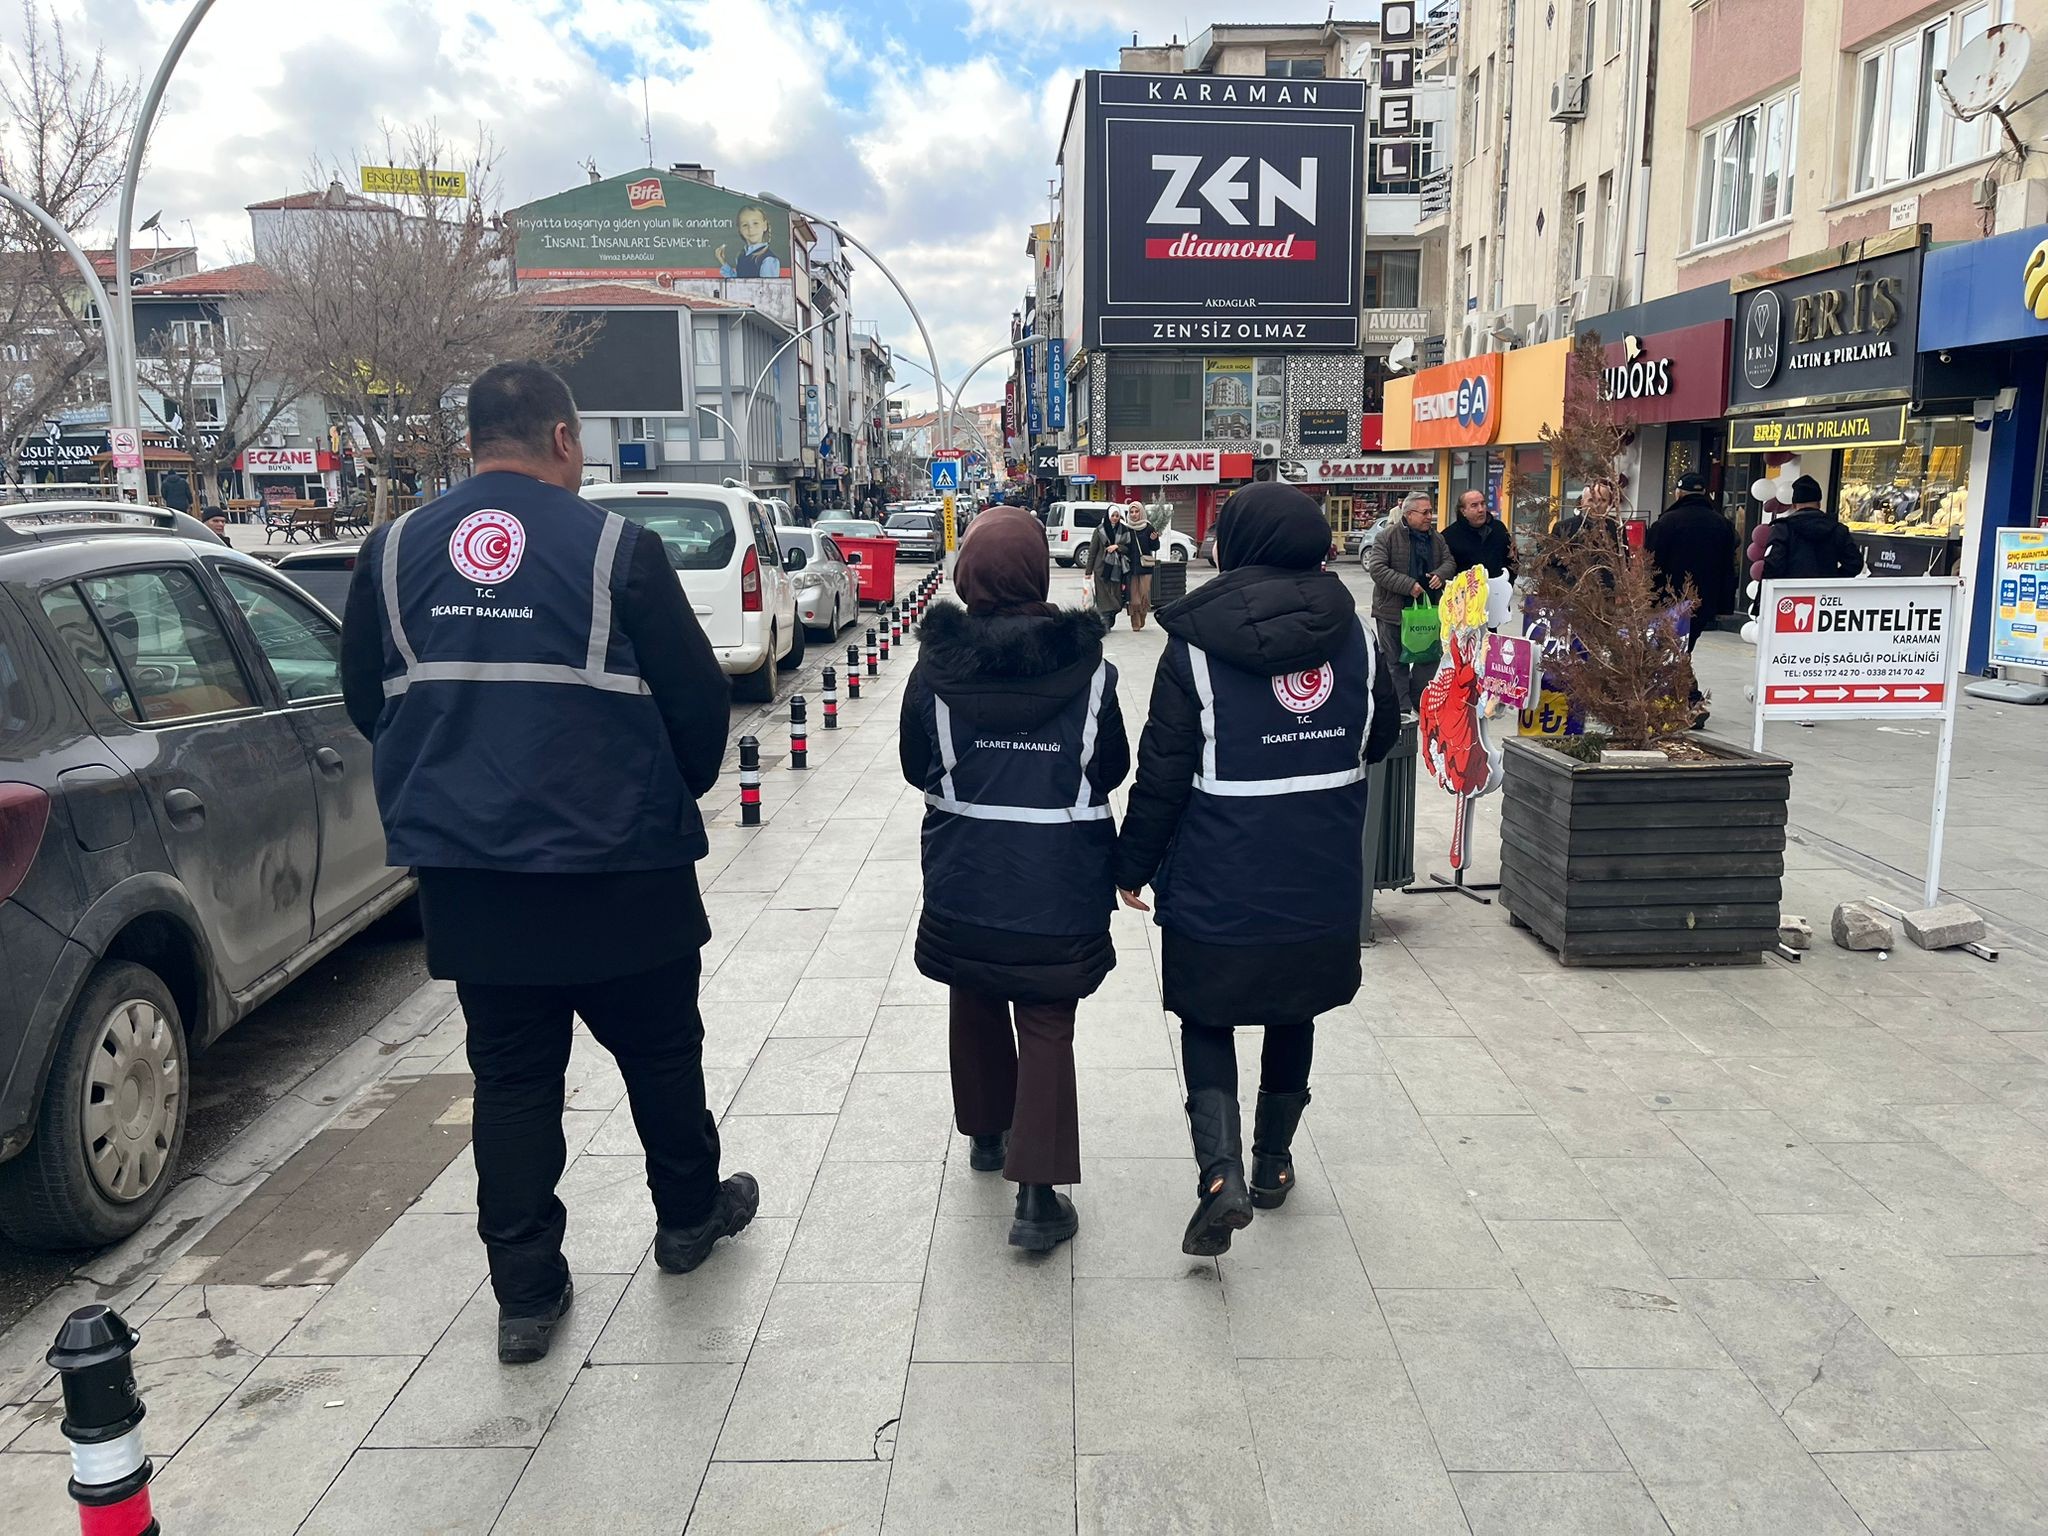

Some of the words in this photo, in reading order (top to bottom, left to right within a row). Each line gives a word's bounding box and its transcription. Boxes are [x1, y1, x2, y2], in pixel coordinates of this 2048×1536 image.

[1149, 82, 1317, 104] KARAMAN
[1383, 6, 1411, 176] OTEL
[429, 175, 460, 188] TIME
[630, 184, 662, 200] Bifa
[1146, 154, 1318, 227] ZEN
[516, 218, 562, 231] Hayatta
[564, 218, 610, 231] başarıya
[613, 218, 640, 232] giden
[643, 218, 670, 231] yolun
[686, 218, 732, 228] anahtarı
[591, 234, 650, 248] İNSANLARI
[1168, 232, 1296, 258] diamond
[622, 252, 655, 261] BABAOĞLU
[1789, 270, 1896, 344] ERİŞ
[1369, 313, 1427, 329] AVUKAT
[1153, 321, 1231, 338] ZEN'SİZ
[1237, 323, 1307, 338] OLMAZ
[1789, 353, 1821, 369] ALTIN
[1823, 351, 1831, 366] &
[1834, 341, 1892, 364] PIRLANTA
[1597, 357, 1669, 401] UDORS
[1413, 383, 1486, 422] TEKNOSA
[807, 401, 818, 435] THK
[1753, 420, 1782, 446] ERİŞ
[1784, 422, 1814, 440] ALTIN
[1816, 418, 1870, 438] PIRLANTA
[57, 445, 100, 459] AKBAY
[248, 451, 312, 464] ECZANE
[1127, 453, 1214, 472] ECZANE
[1318, 459, 1385, 477] ÖZAKIN
[1162, 474, 1179, 483] IŞIK
[475, 588, 495, 598] T.C.
[1820, 595, 1843, 606] ÖZEL
[431, 605, 474, 617] TİCARET
[476, 606, 533, 619] BAKANLIĞI
[1818, 601, 1942, 632] DENTELİTE
[1893, 635, 1940, 644] KARAMAN
[1772, 653, 1797, 664] AĞIZ
[1813, 652, 1830, 666] DİŞ
[1833, 652, 1874, 663] SAĞLIĞI
[1876, 651, 1939, 663] POLİKLİNİĞİ
[1802, 669, 1822, 677] 0552
[1915, 668, 1925, 676] 42
[1297, 715, 1312, 724] T.C.
[1261, 732, 1298, 744] TİCARET
[1299, 726, 1346, 740] BAKANLIĞI
[974, 739, 1011, 749] TİCARET
[1012, 741, 1061, 752] BAKANLIĞI
